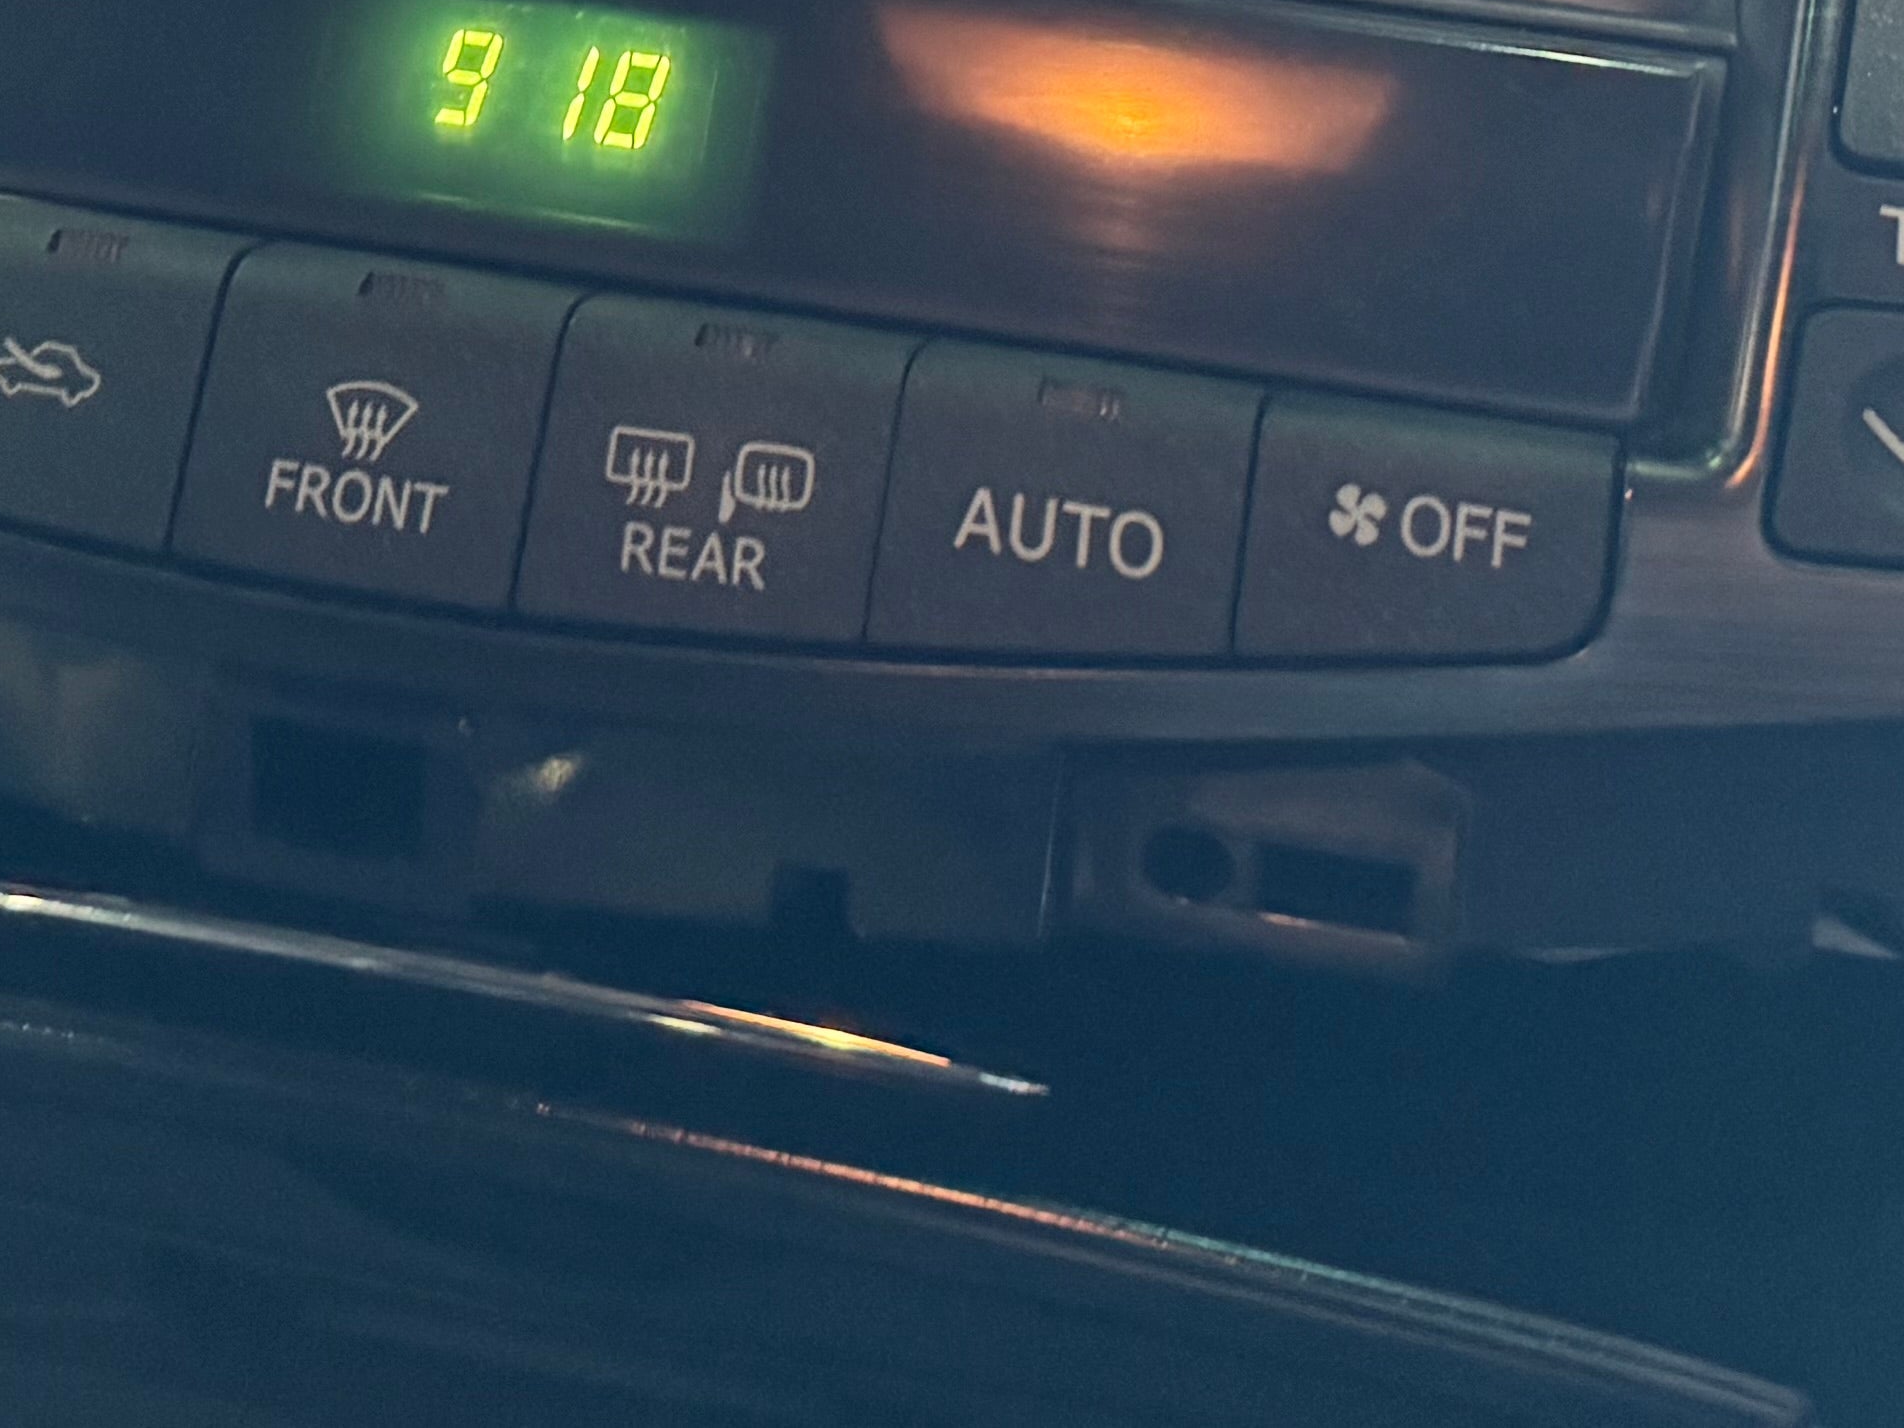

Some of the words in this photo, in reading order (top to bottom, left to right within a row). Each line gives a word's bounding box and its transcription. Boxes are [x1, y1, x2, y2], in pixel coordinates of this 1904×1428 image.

[264, 459, 450, 535] FRONT
[953, 487, 1166, 580] AUTO
[1400, 494, 1533, 569] OFF
[620, 520, 766, 592] REAR
